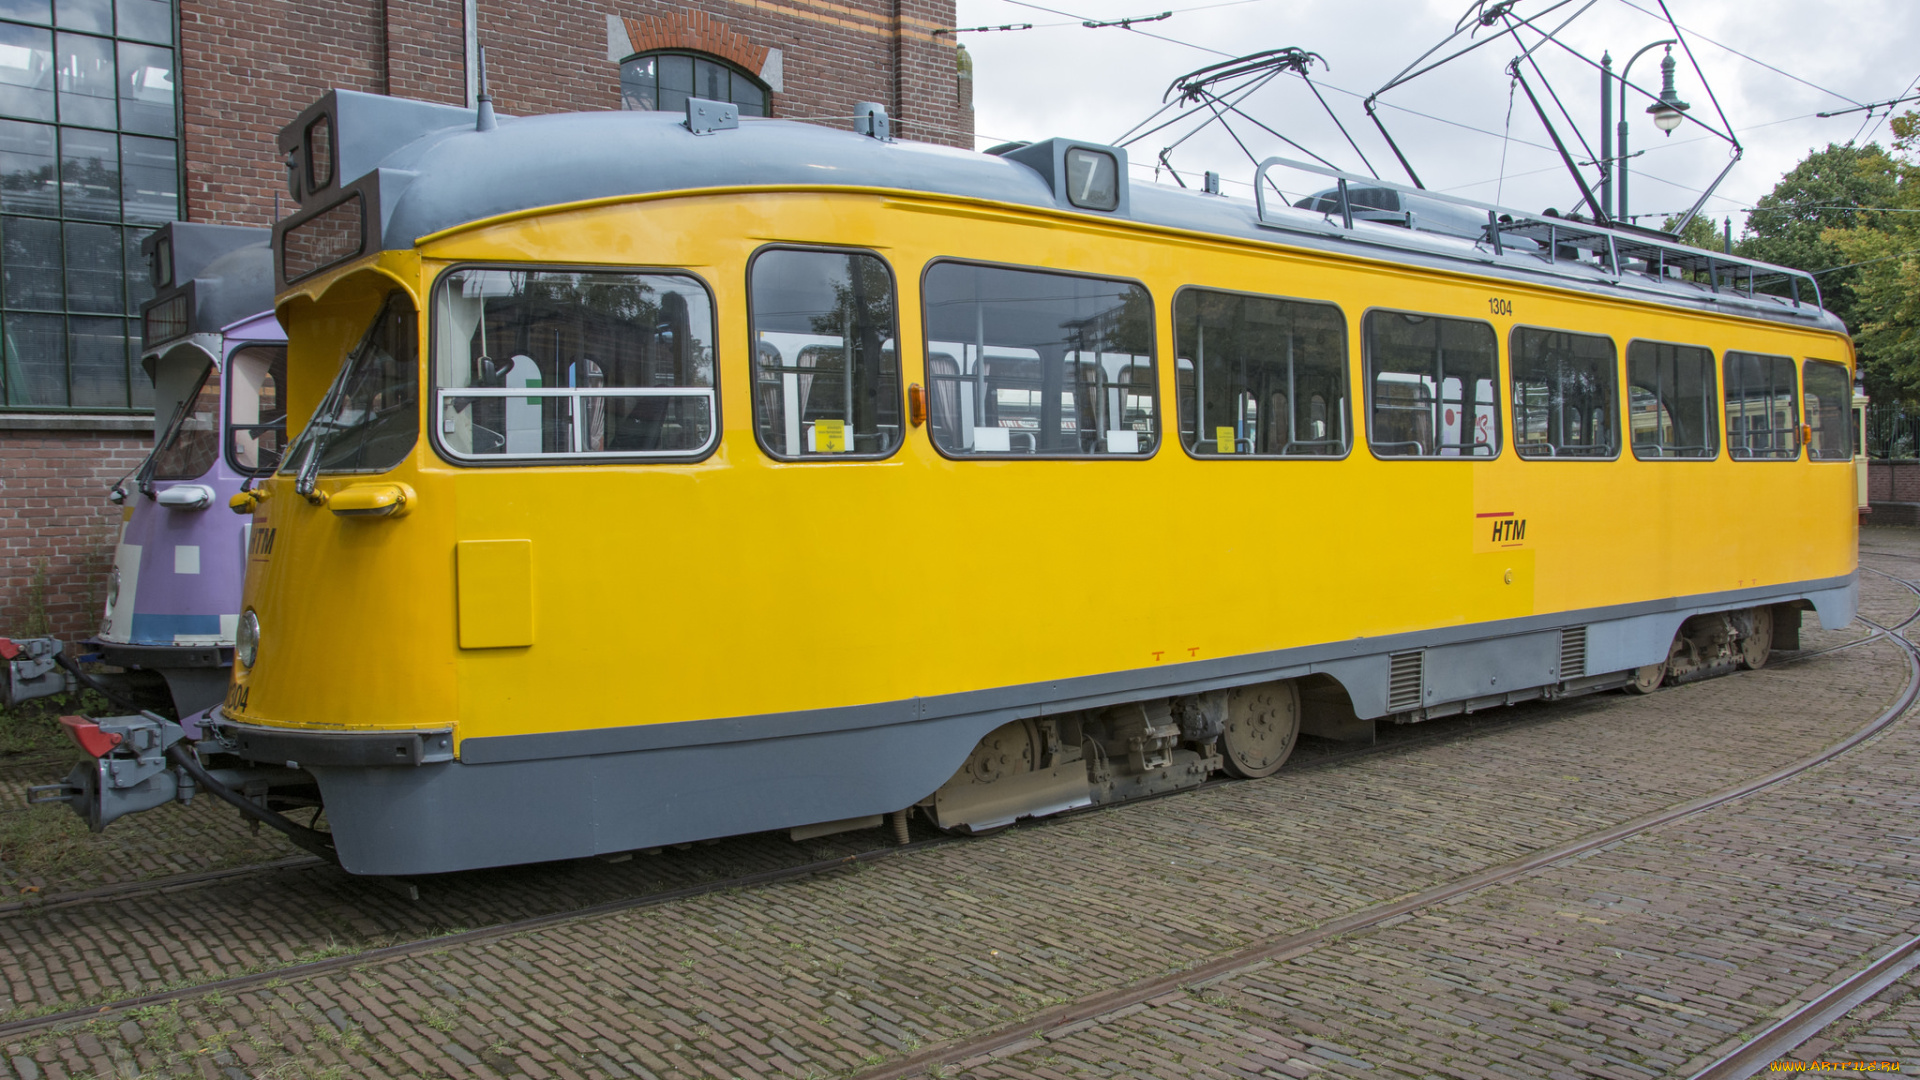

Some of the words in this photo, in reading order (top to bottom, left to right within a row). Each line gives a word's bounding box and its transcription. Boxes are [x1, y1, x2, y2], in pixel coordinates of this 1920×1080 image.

[1078, 154, 1099, 200] 7
[1488, 297, 1512, 316] 1304
[1492, 519, 1526, 542] HTM
